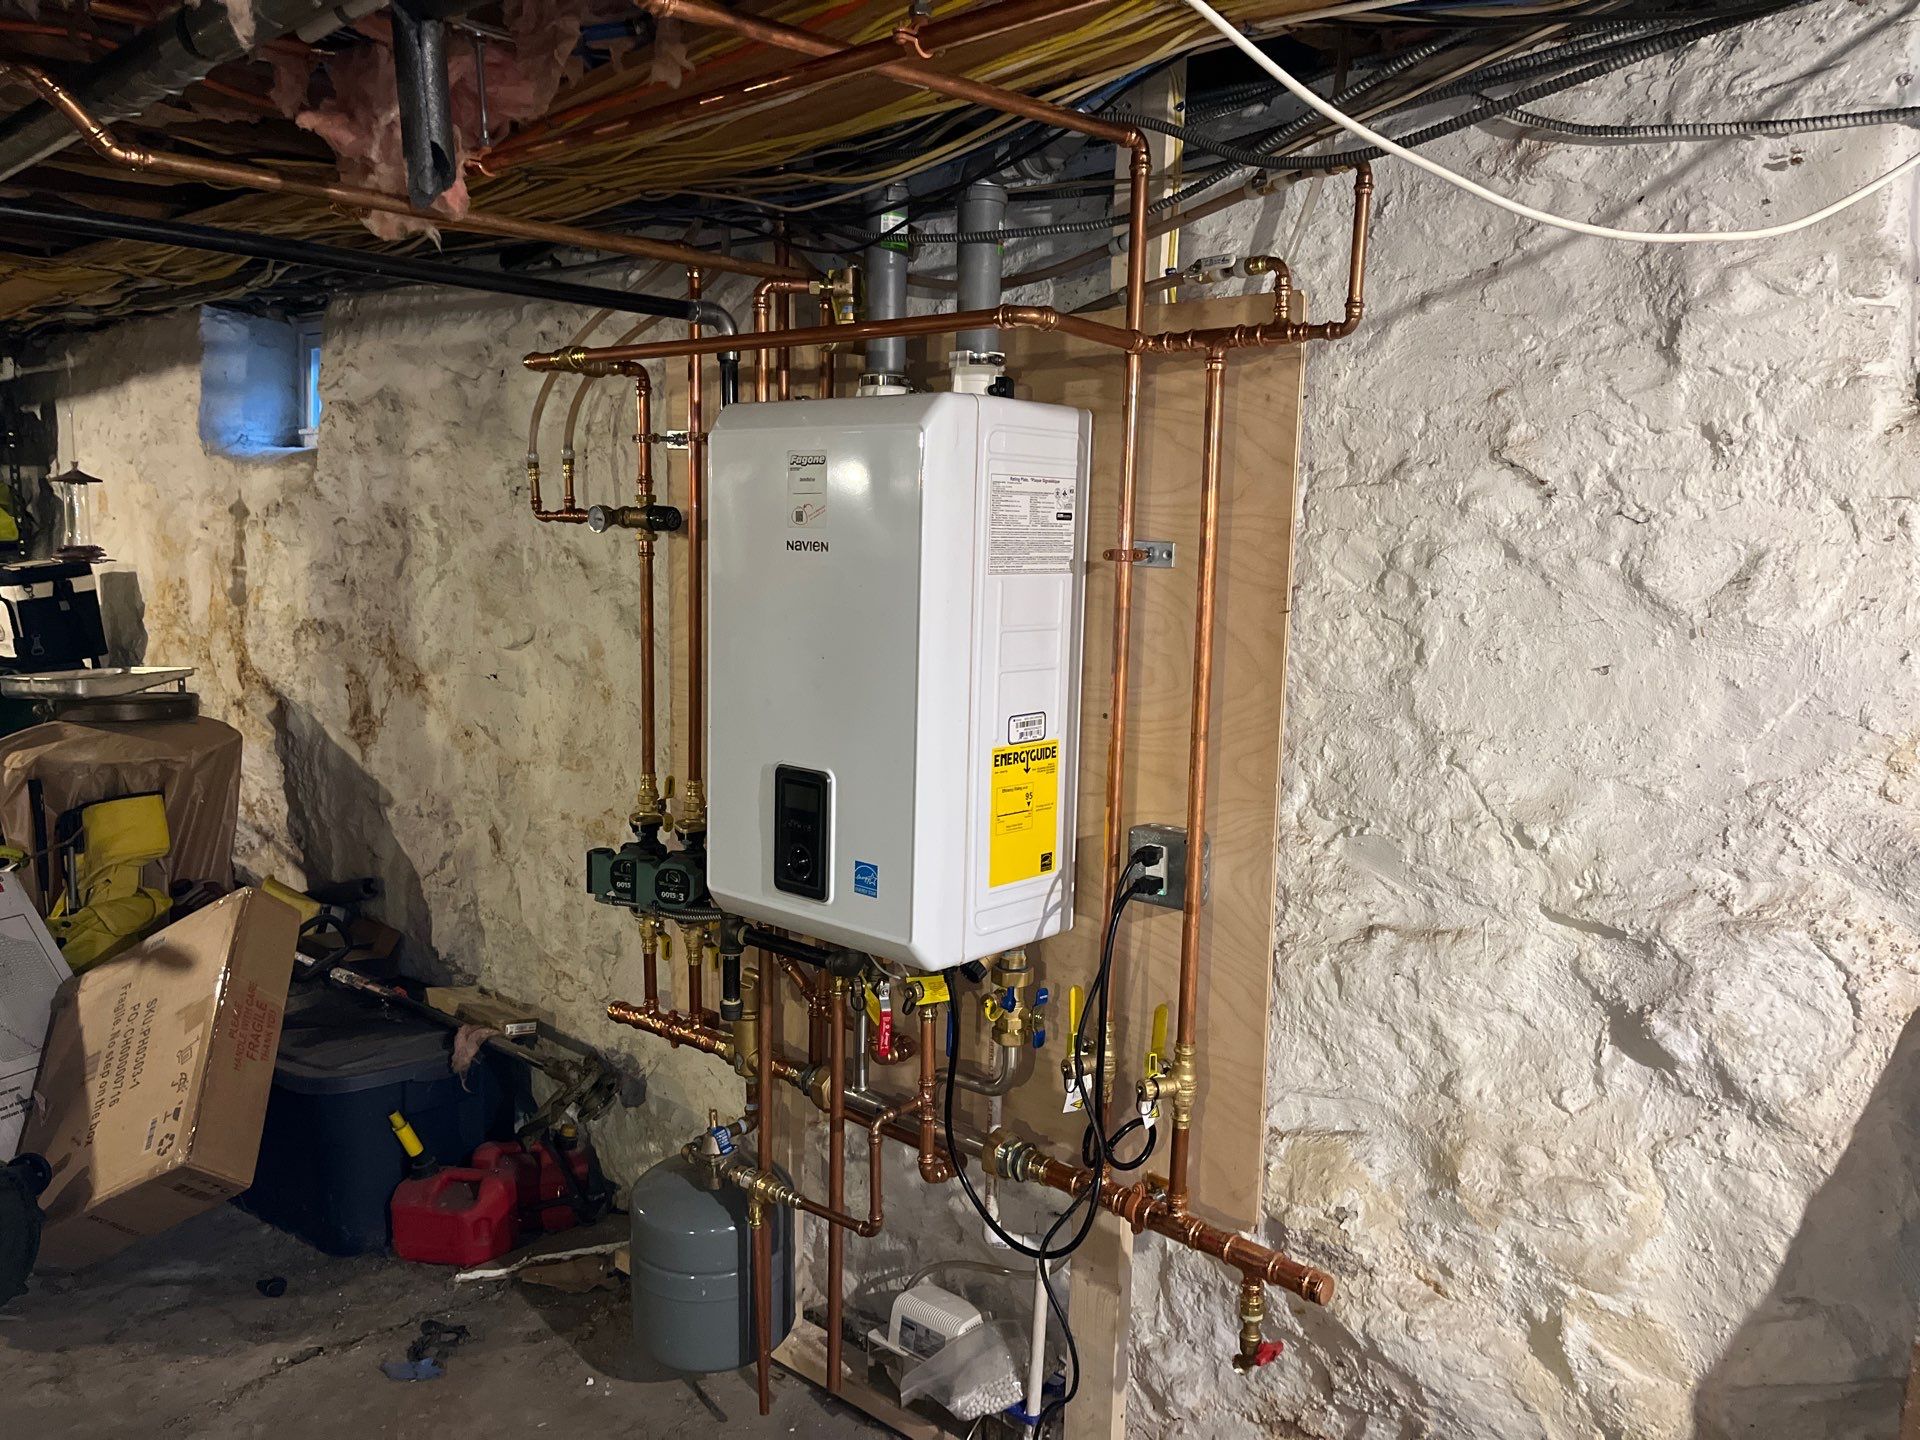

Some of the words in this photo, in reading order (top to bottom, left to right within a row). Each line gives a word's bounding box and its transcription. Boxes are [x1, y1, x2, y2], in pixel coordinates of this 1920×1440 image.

[790, 454, 825, 466] Fagone
[994, 745, 1057, 768] ENERGYGUIDE
[1025, 792, 1033, 800] 95
[616, 881, 631, 889] 0015
[107, 1030, 121, 1049] No
[246, 1000, 267, 1061] FRAGILE
[100, 1052, 113, 1078] step
[95, 1081, 108, 1099] on
[91, 1097, 106, 1121] the
[84, 1120, 101, 1148] box
